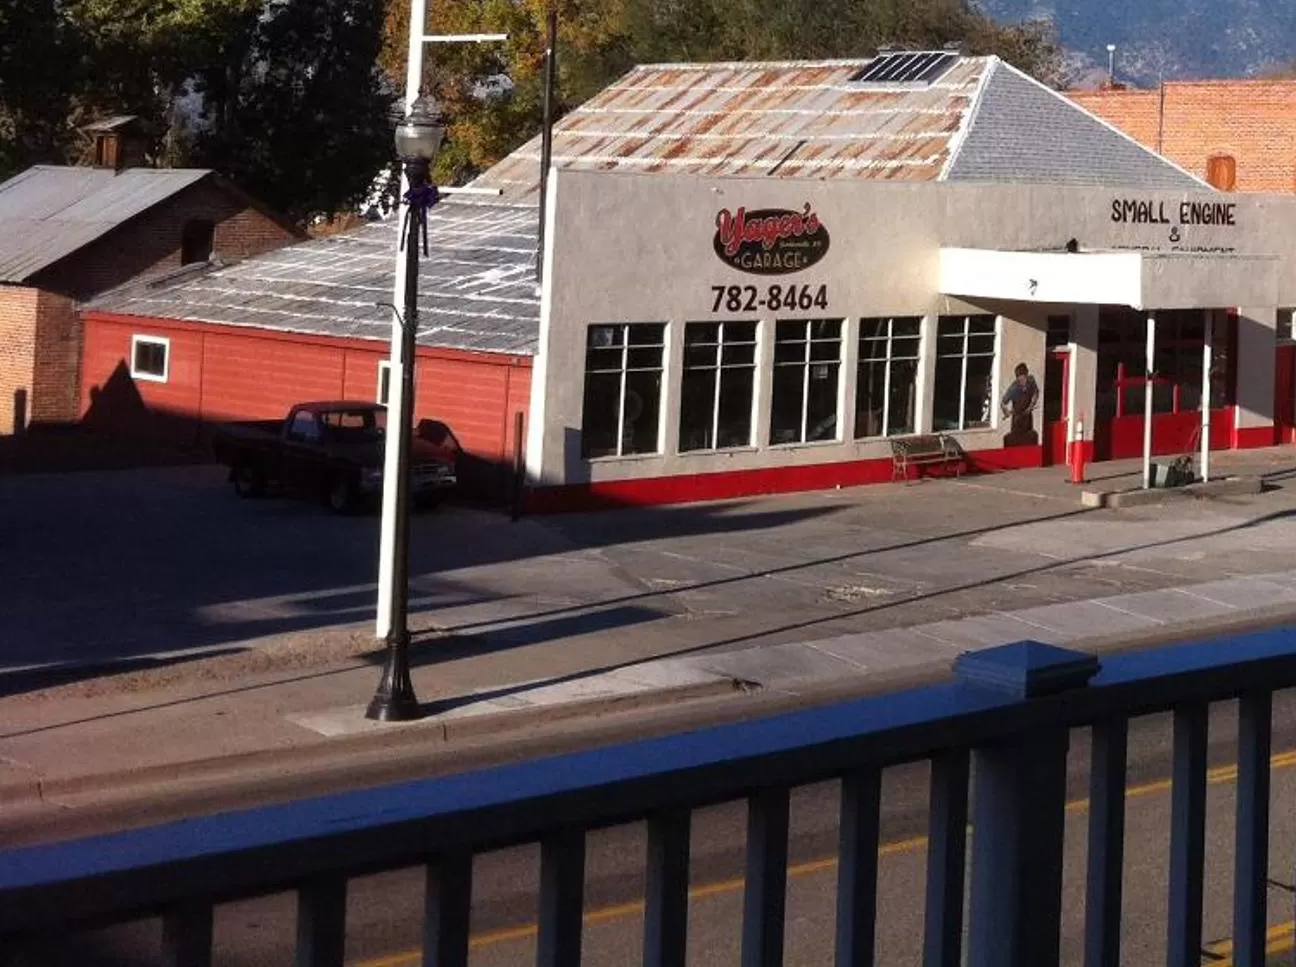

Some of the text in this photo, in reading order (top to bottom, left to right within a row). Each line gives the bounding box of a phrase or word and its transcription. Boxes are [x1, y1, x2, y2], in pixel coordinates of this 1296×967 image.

[1111, 199, 1236, 225] SMALL ENGINE
[740, 251, 801, 268] GARAGE
[711, 284, 828, 313] 782-8464
